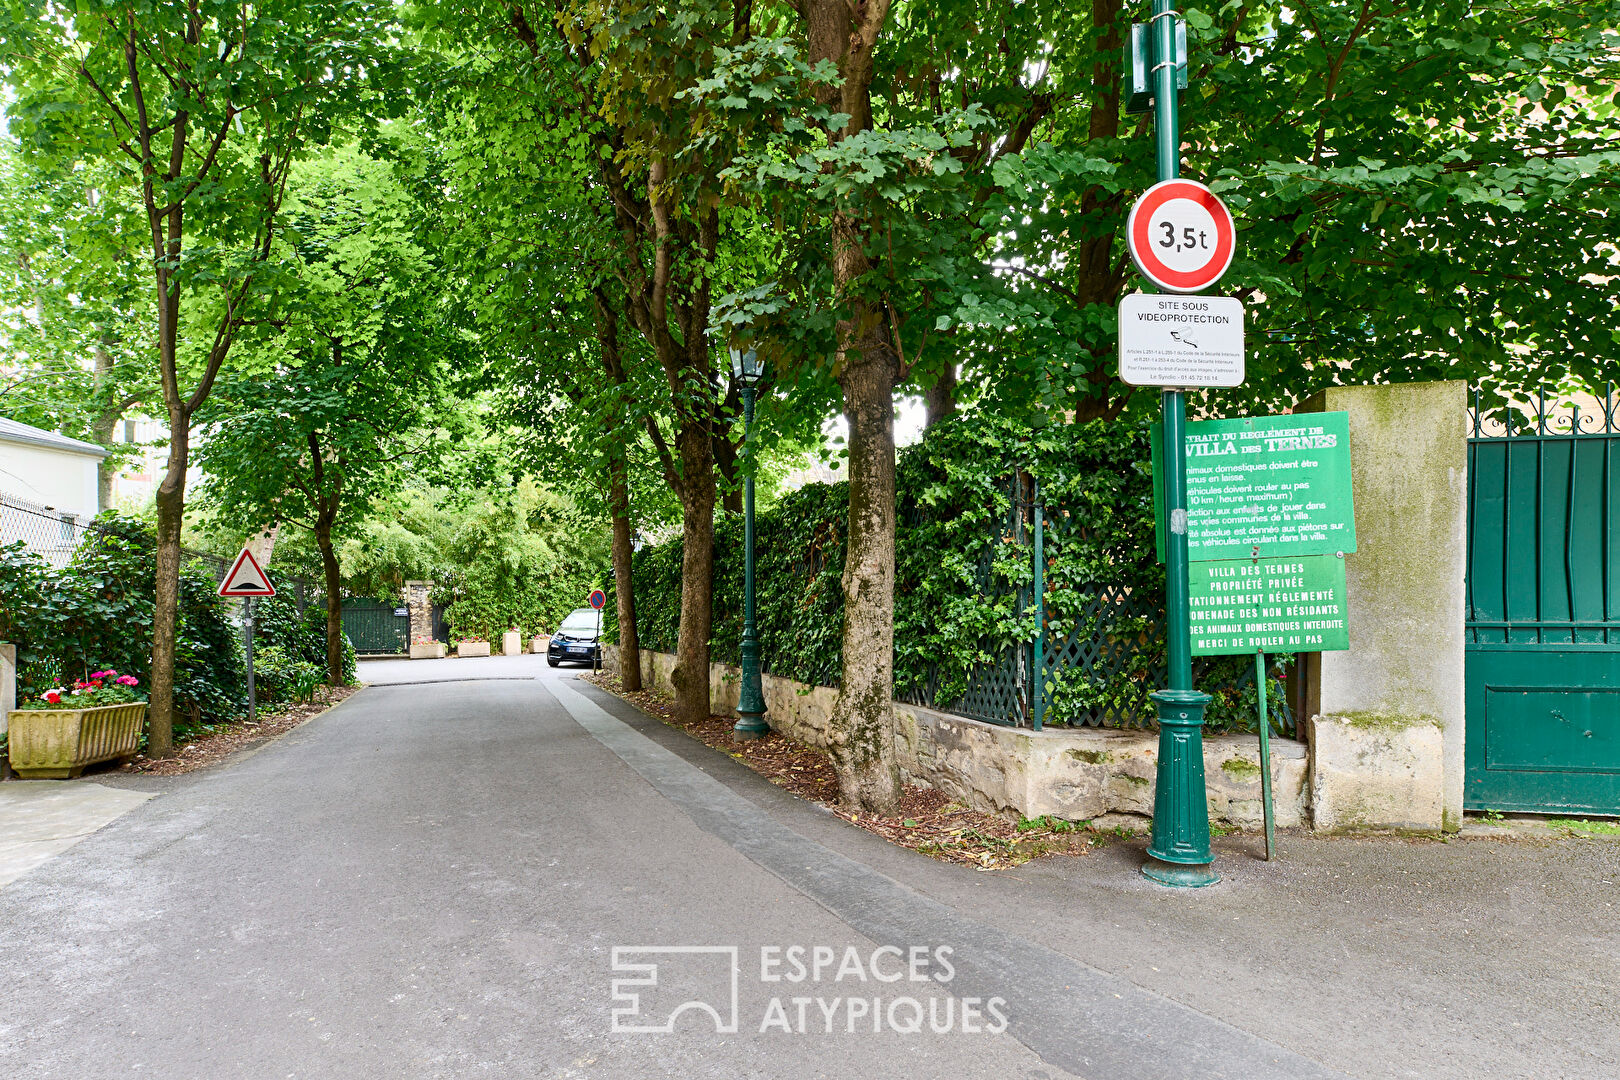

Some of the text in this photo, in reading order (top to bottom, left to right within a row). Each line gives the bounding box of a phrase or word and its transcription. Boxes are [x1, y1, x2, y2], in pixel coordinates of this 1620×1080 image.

[1158, 301, 1209, 311] SITE SOUS
[1137, 313, 1229, 324] VIDEOPROTECTION
[1186, 434, 1219, 443] TRAIT
[1222, 433, 1236, 441] DU
[1308, 426, 1324, 435] DE
[1241, 445, 1261, 454] DES
[1264, 434, 1337, 452] TERNES
[1186, 459, 1318, 475] nimaux domestiques doivent être
[1222, 474, 1246, 482] laisse.
[1223, 484, 1252, 494] doivent
[1254, 482, 1279, 492] rouler
[1294, 482, 1310, 491] pas
[1187, 508, 1214, 517] diction
[1267, 504, 1278, 512] de
[1280, 502, 1303, 513] jouer
[1305, 501, 1326, 510] dans
[1188, 517, 1198, 526] les
[1200, 517, 1220, 526] voies
[1222, 515, 1268, 525] communes
[1270, 513, 1281, 522] de
[1283, 512, 1291, 521] la
[1201, 528, 1231, 537] absolue
[1233, 527, 1246, 536] est
[1248, 525, 1279, 535] donnée
[1281, 525, 1296, 533] aux
[1298, 522, 1328, 534] piétons
[1330, 522, 1344, 530] sur
[1188, 538, 1199, 547] les
[1202, 536, 1240, 547] véhicules
[1242, 534, 1277, 545] circulant
[1279, 533, 1299, 542] dans
[1300, 532, 1308, 541] la
[1208, 563, 1304, 577] VILLA DES TERNES
[1210, 576, 1304, 592] PROPRIÉTÉ PRIVÉE
[1189, 588, 1334, 607] TATIONNEMENT RÉGLEMENTÉ
[1190, 604, 1339, 621] OMENADE DES NON RÉSIDANTS
[1207, 623, 1242, 635] ANIMAUX
[1245, 621, 1300, 633] DOMESTIQUES
[1303, 619, 1343, 630] INTERDITE
[1198, 634, 1323, 649] MERCI DE ROULER AU PAS
